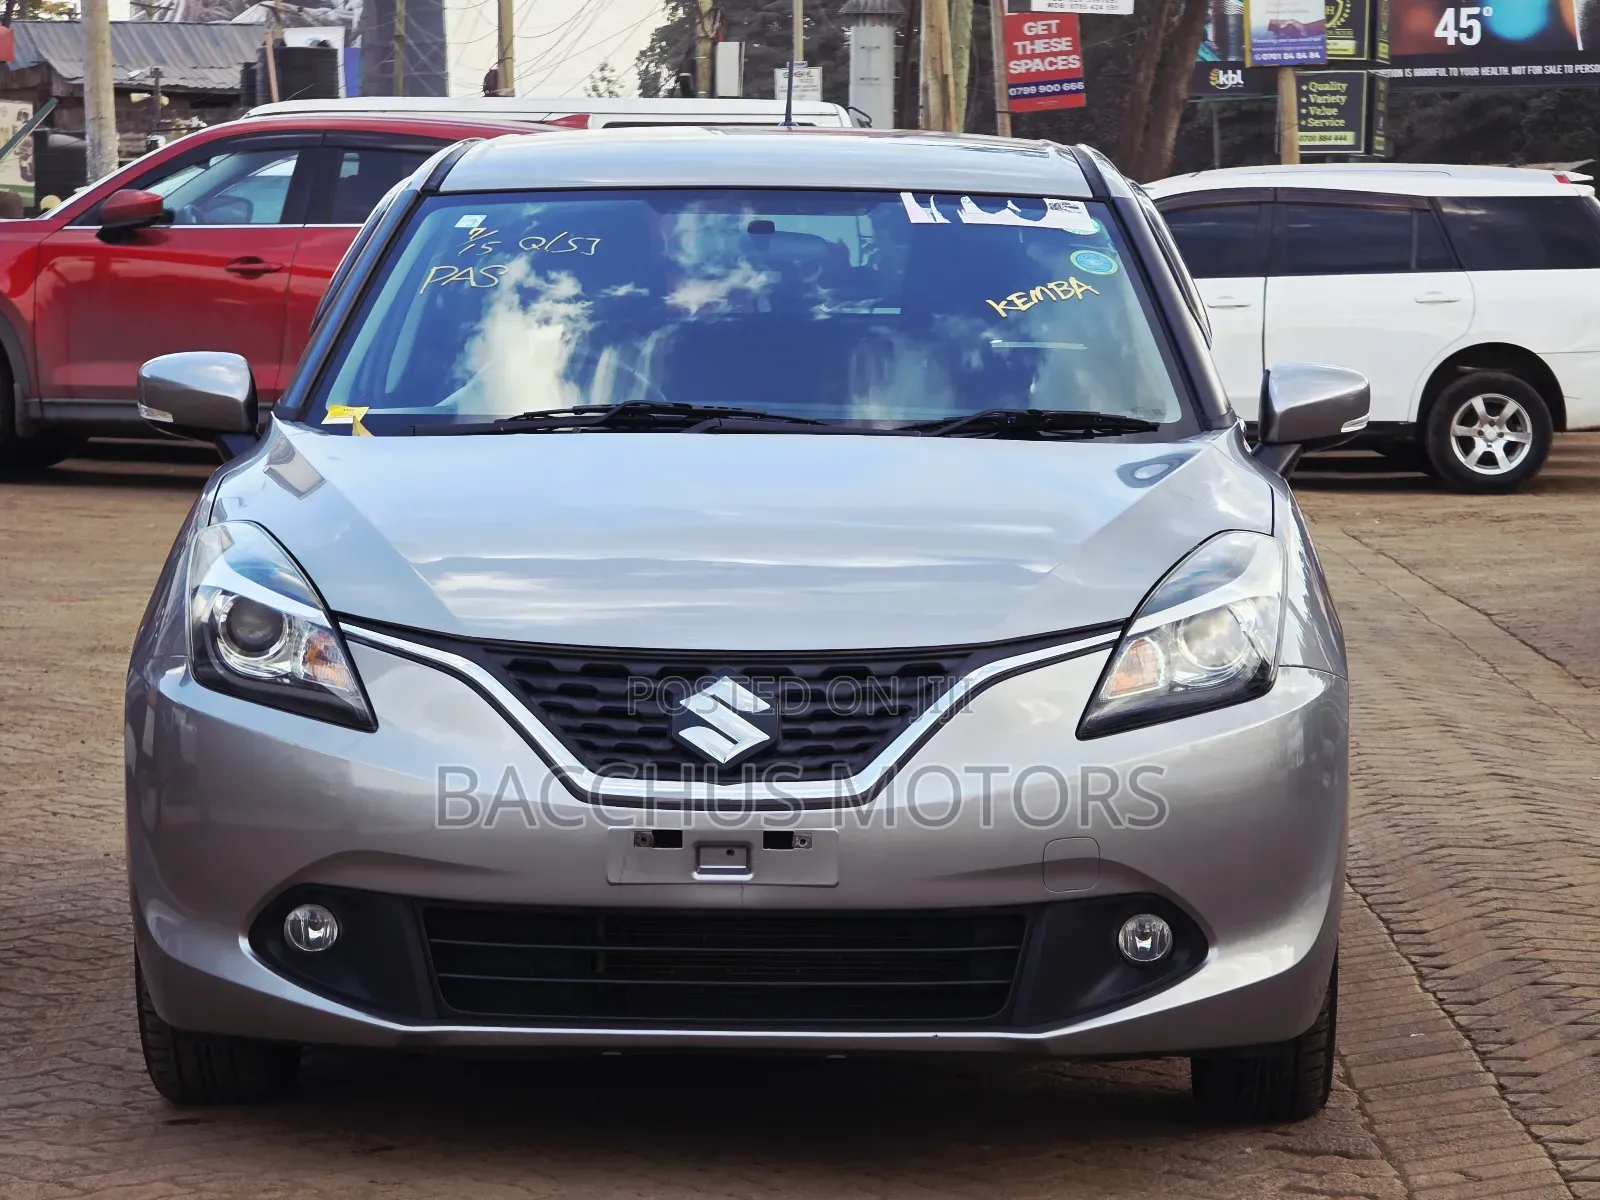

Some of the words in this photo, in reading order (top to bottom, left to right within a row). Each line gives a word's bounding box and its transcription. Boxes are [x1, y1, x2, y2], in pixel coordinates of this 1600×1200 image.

[1023, 20, 1060, 36] GET
[1013, 37, 1073, 55] THESE
[1008, 55, 1081, 74] SPACES
[1404, 68, 1413, 78] IS
[1449, 67, 1459, 76] TO
[1459, 66, 1480, 76] YOUR
[1511, 65, 1527, 75] NOT
[1527, 65, 1543, 75] FOR
[1543, 64, 1563, 74] SALE
[1563, 64, 1574, 74] TO
[1008, 86, 1038, 96] 0799
[1038, 84, 1061, 93] 900
[1308, 81, 1348, 92] Quality
[1308, 93, 1348, 105] Variety
[1308, 105, 1339, 116] Value
[1307, 117, 1346, 127] Service
[418, 264, 509, 295] PAS
[985, 276, 1100, 318] KEMBA
